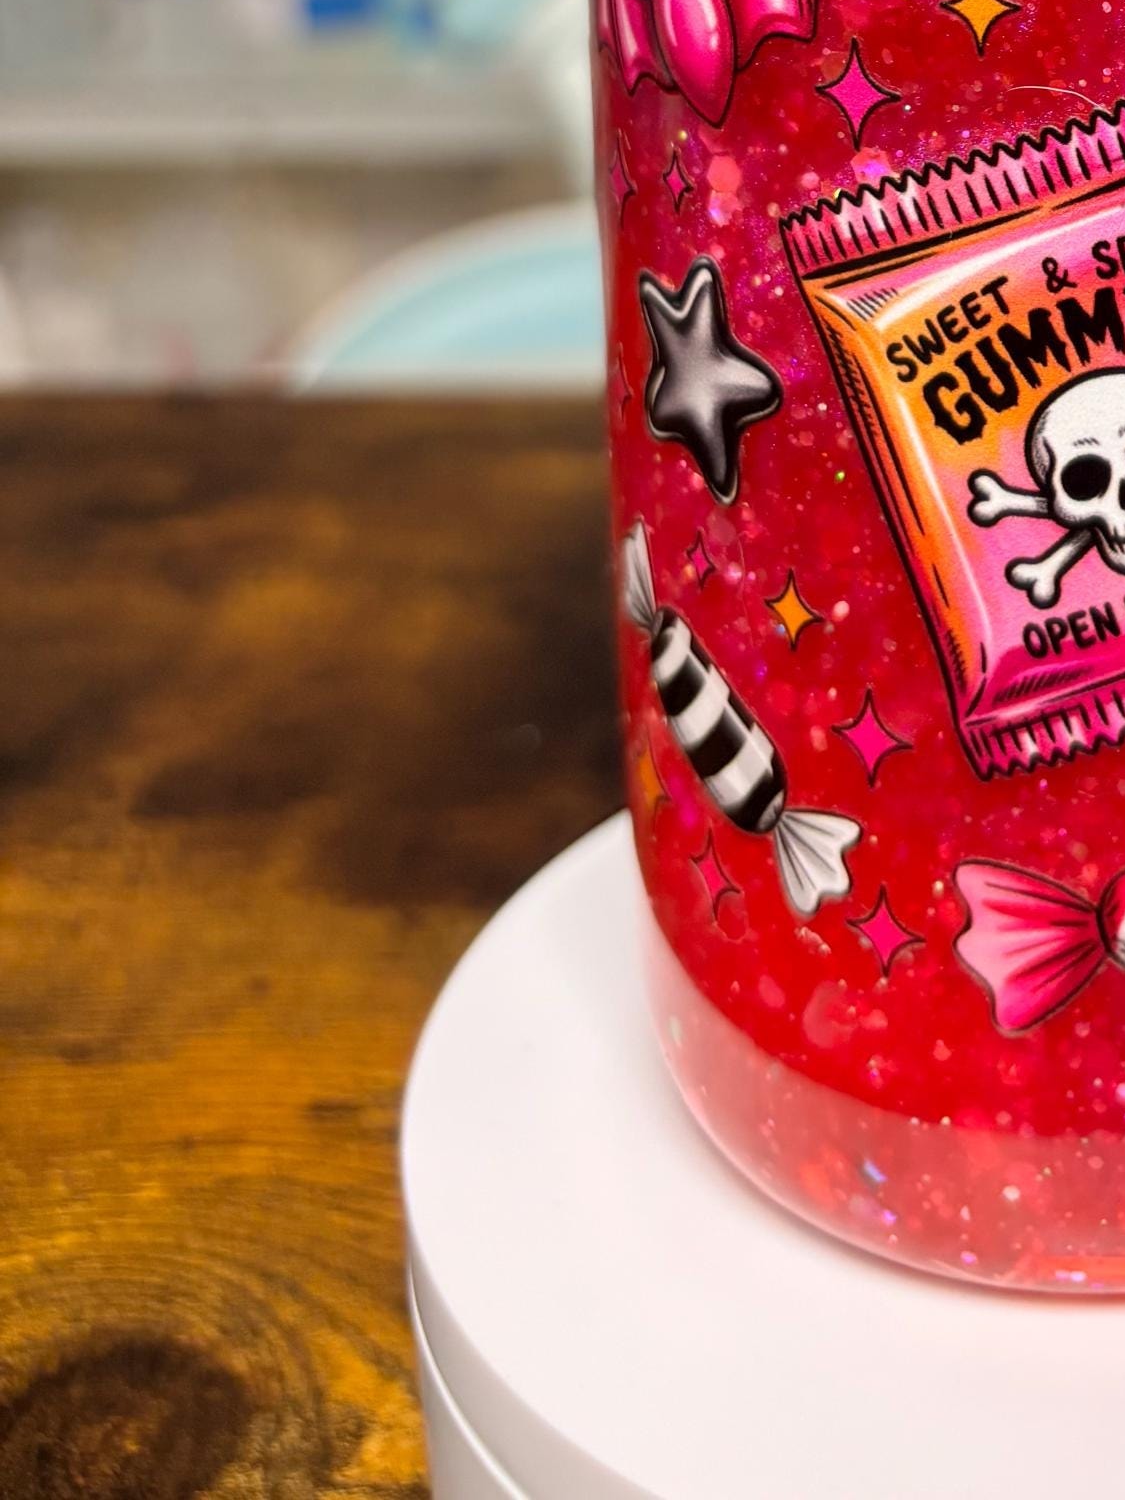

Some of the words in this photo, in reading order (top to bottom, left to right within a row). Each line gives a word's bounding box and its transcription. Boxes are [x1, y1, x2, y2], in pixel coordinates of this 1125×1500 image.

[886, 276, 1009, 383] SWEET
[1041, 256, 1077, 294] &
[1022, 601, 1121, 658] OPEN
